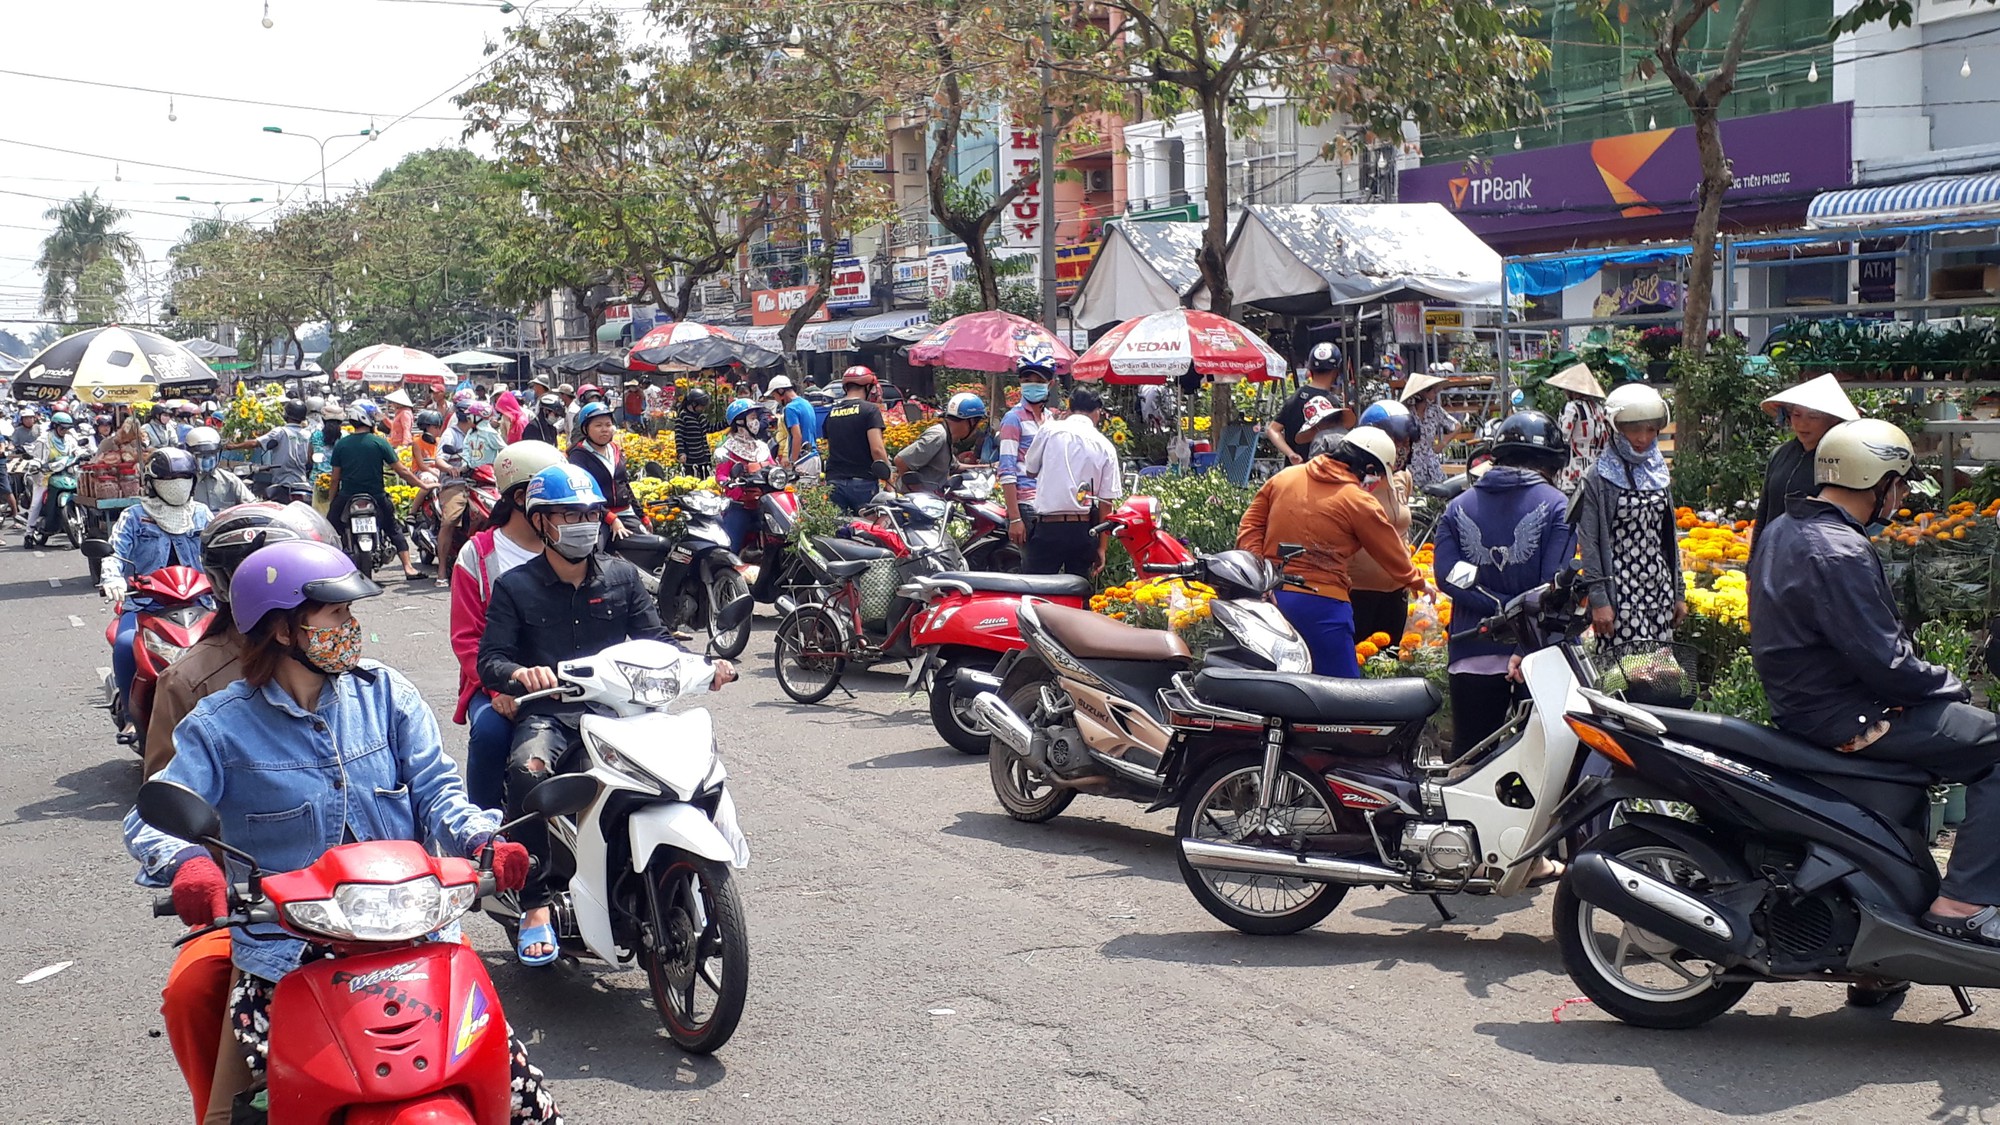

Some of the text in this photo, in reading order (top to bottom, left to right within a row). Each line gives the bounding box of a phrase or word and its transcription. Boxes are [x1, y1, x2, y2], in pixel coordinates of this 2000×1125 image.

[1762, 172, 1791, 187] PHONG
[1470, 173, 1532, 205] TPBank
[1863, 262, 1892, 278] ATM
[1628, 273, 1660, 304] 2018
[1126, 341, 1182, 353] VEDAN
[38, 386, 61, 400] 099
[107, 387, 139, 395] mobile
[246, 530, 254, 540] 9
[1077, 698, 1109, 723] SUZUKI
[1342, 793, 1386, 805] Dream
